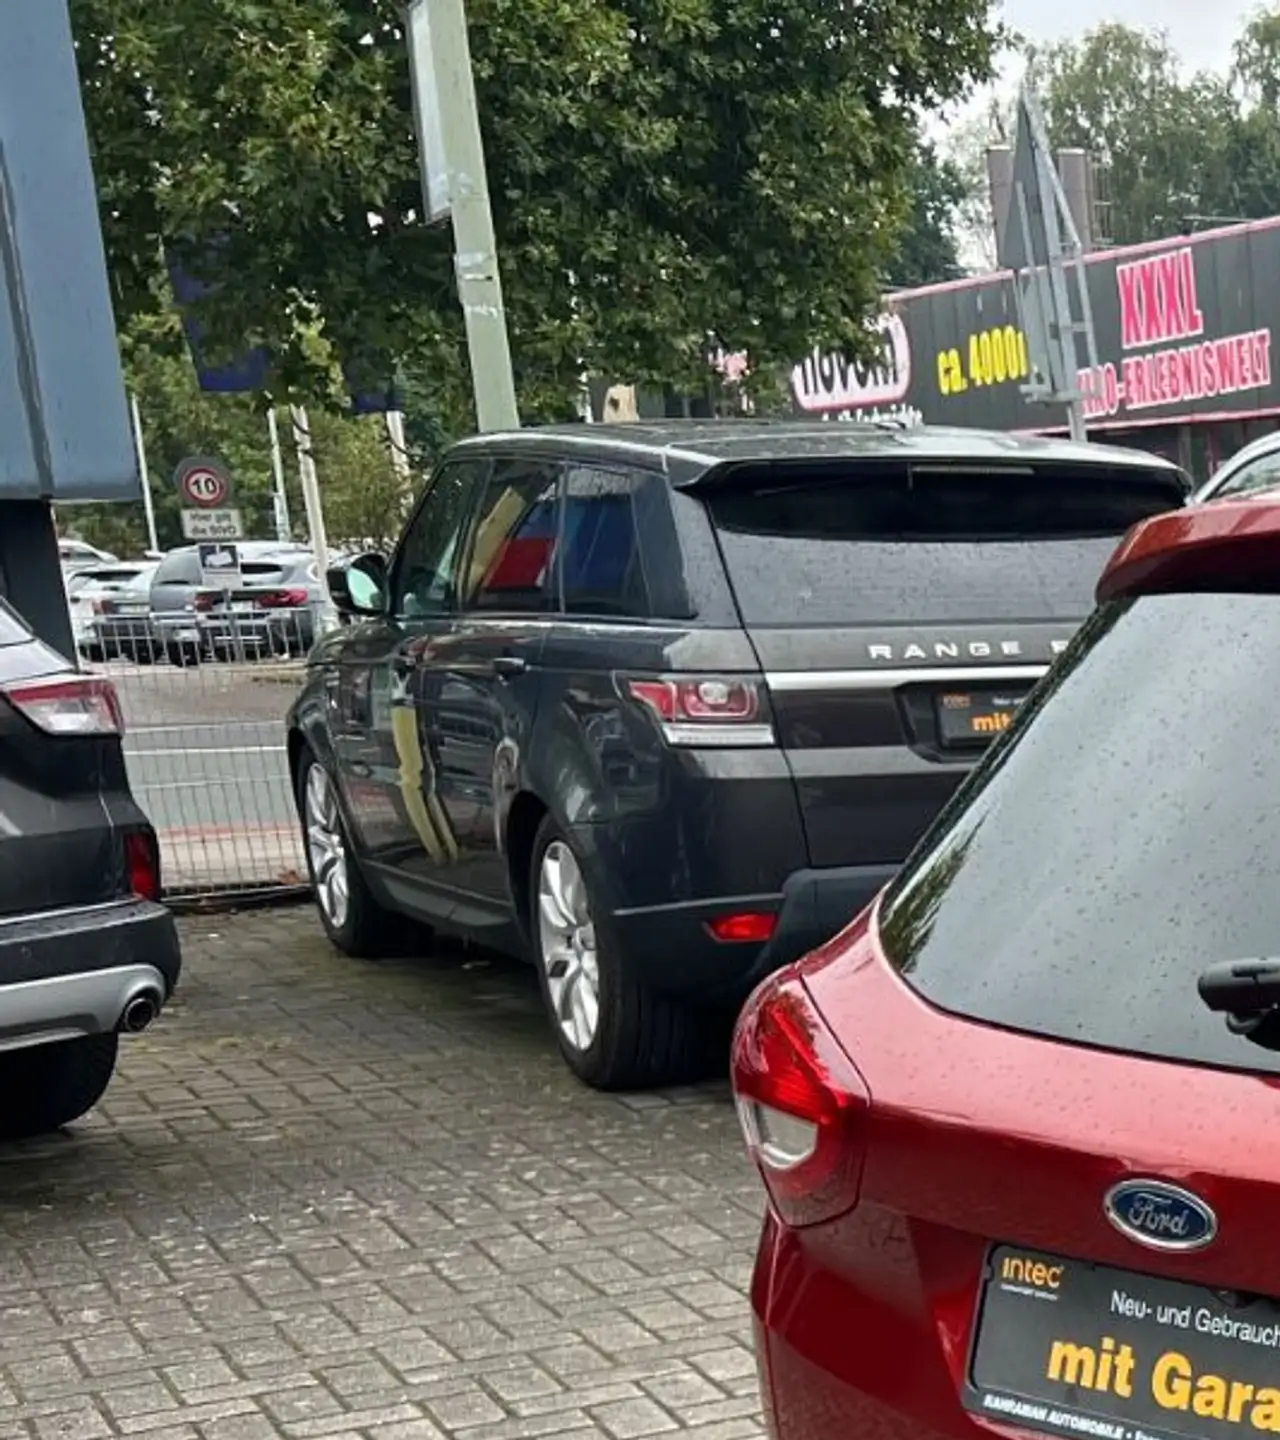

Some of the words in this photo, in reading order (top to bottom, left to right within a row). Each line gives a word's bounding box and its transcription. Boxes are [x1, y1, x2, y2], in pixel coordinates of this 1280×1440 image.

[1117, 247, 1203, 349] XXXL
[937, 348, 968, 396] ca.
[192, 477, 217, 495] 10
[868, 640, 1022, 660] RANGE
[1127, 1192, 1190, 1236] Ford
[1110, 1289, 1152, 1320] Neu-
[1156, 1305, 1192, 1328] und
[1047, 1336, 1135, 1398] mit
